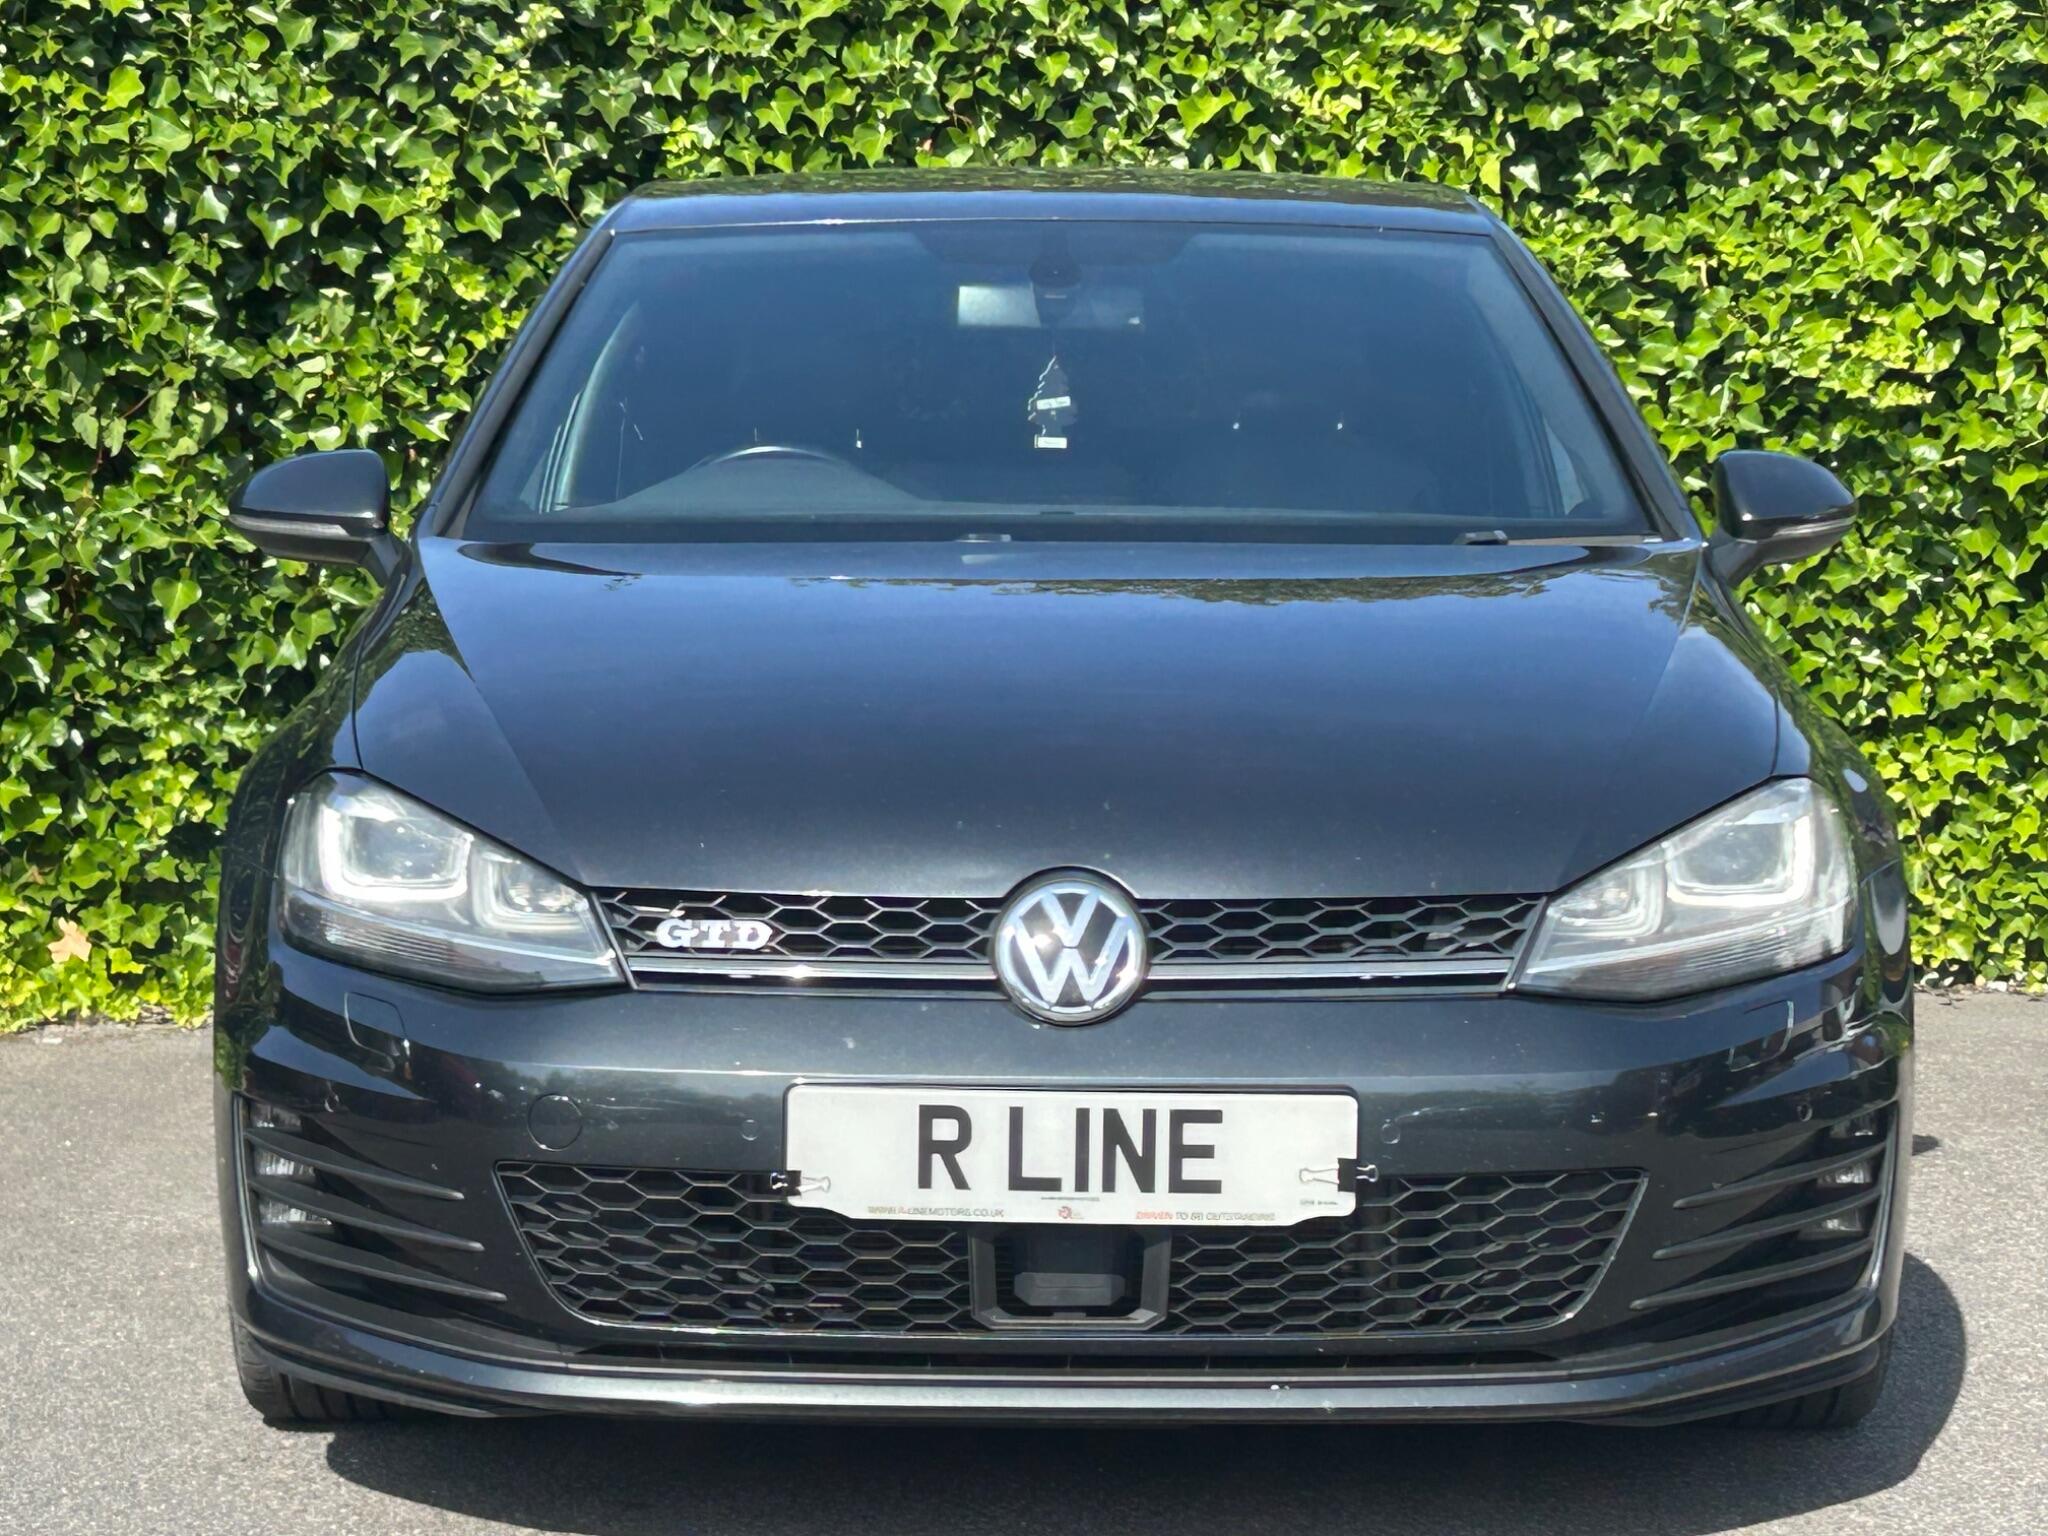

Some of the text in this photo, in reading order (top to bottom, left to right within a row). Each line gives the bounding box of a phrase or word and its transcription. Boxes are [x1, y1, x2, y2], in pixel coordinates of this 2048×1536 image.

[656, 919, 773, 949] GTD
[917, 1104, 1223, 1194] R LINE
